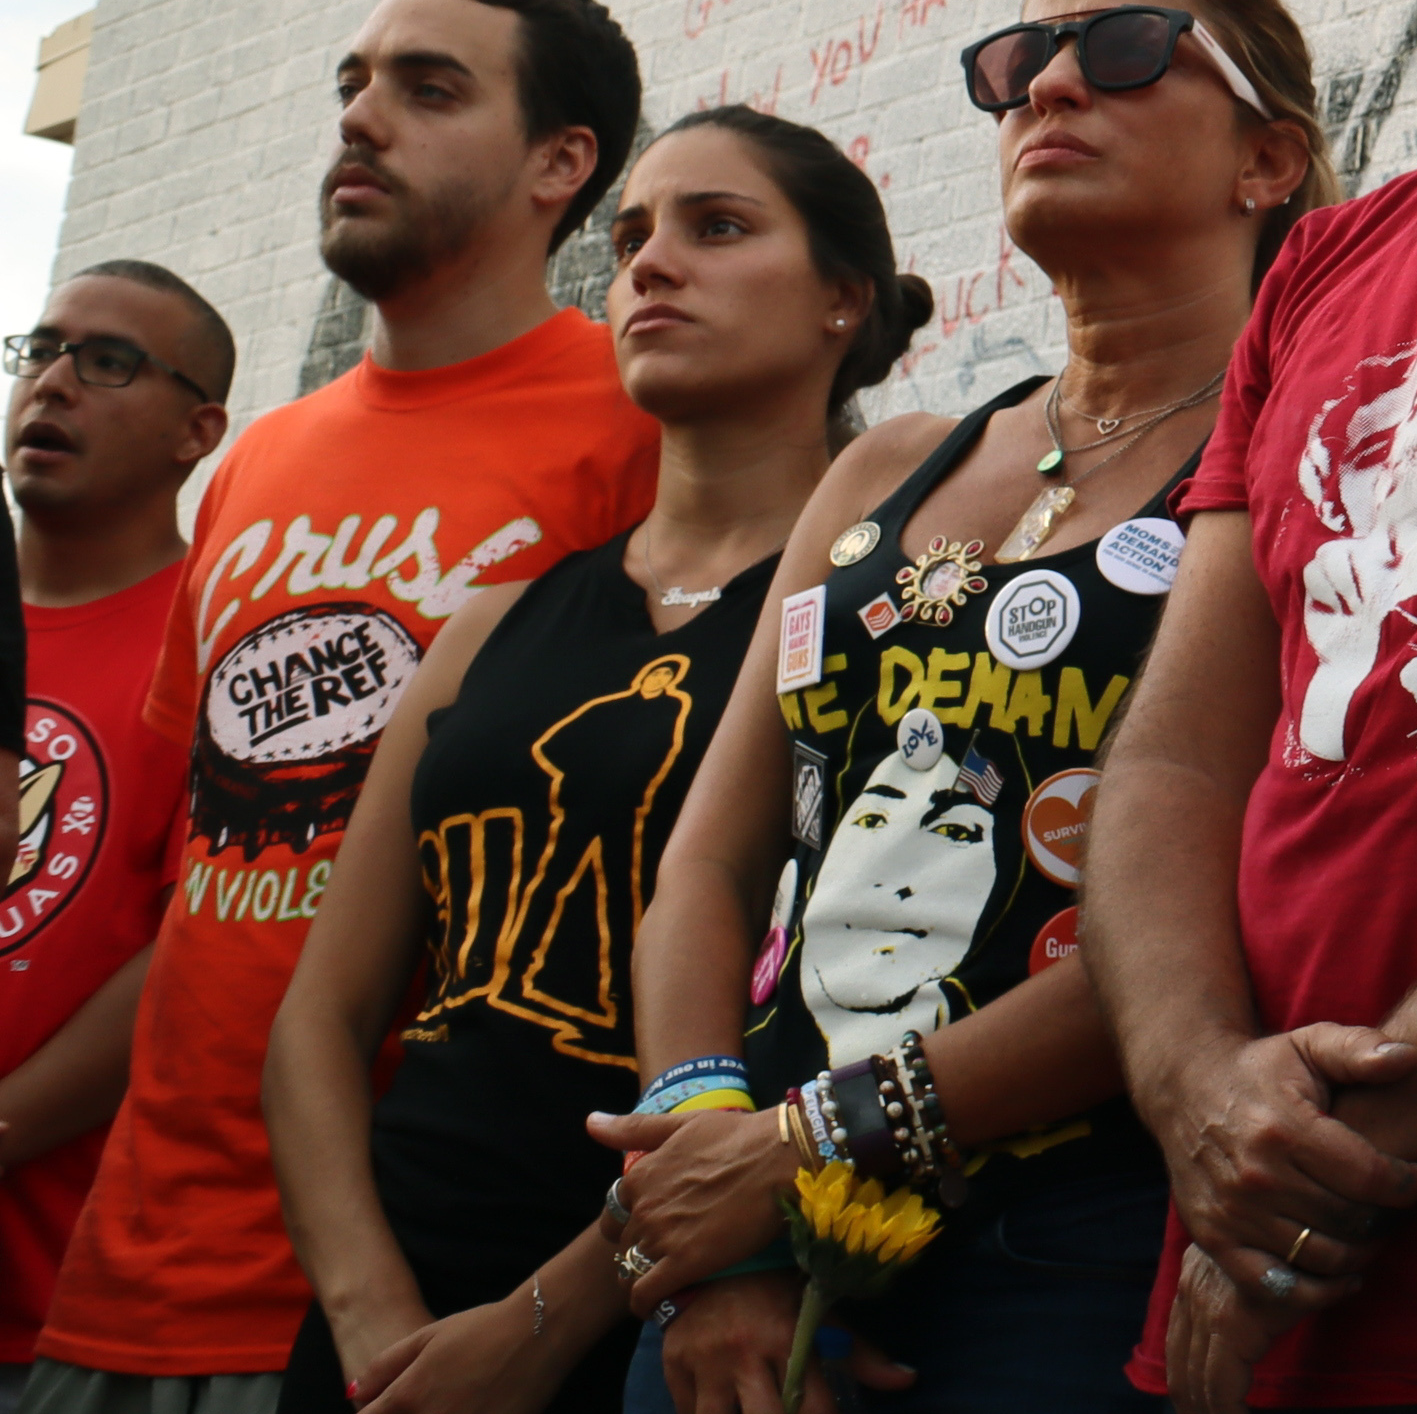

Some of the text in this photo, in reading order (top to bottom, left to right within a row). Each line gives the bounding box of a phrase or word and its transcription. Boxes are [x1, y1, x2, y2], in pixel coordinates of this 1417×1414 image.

[810, 2, 883, 104] YOU
[1115, 531, 1180, 568] DEMAND
[1123, 523, 1172, 551] MOMS
[1107, 541, 1166, 573] ACTION
[788, 610, 812, 636] GAYS
[1008, 595, 1057, 625] STOP
[1007, 616, 1057, 637] HANDGUN
[227, 620, 382, 706] CHANGE
[238, 649, 389, 737] THE REF
[901, 719, 939, 759] LOVE
[664, 1062, 695, 1081] our
[696, 1058, 716, 1070] in
